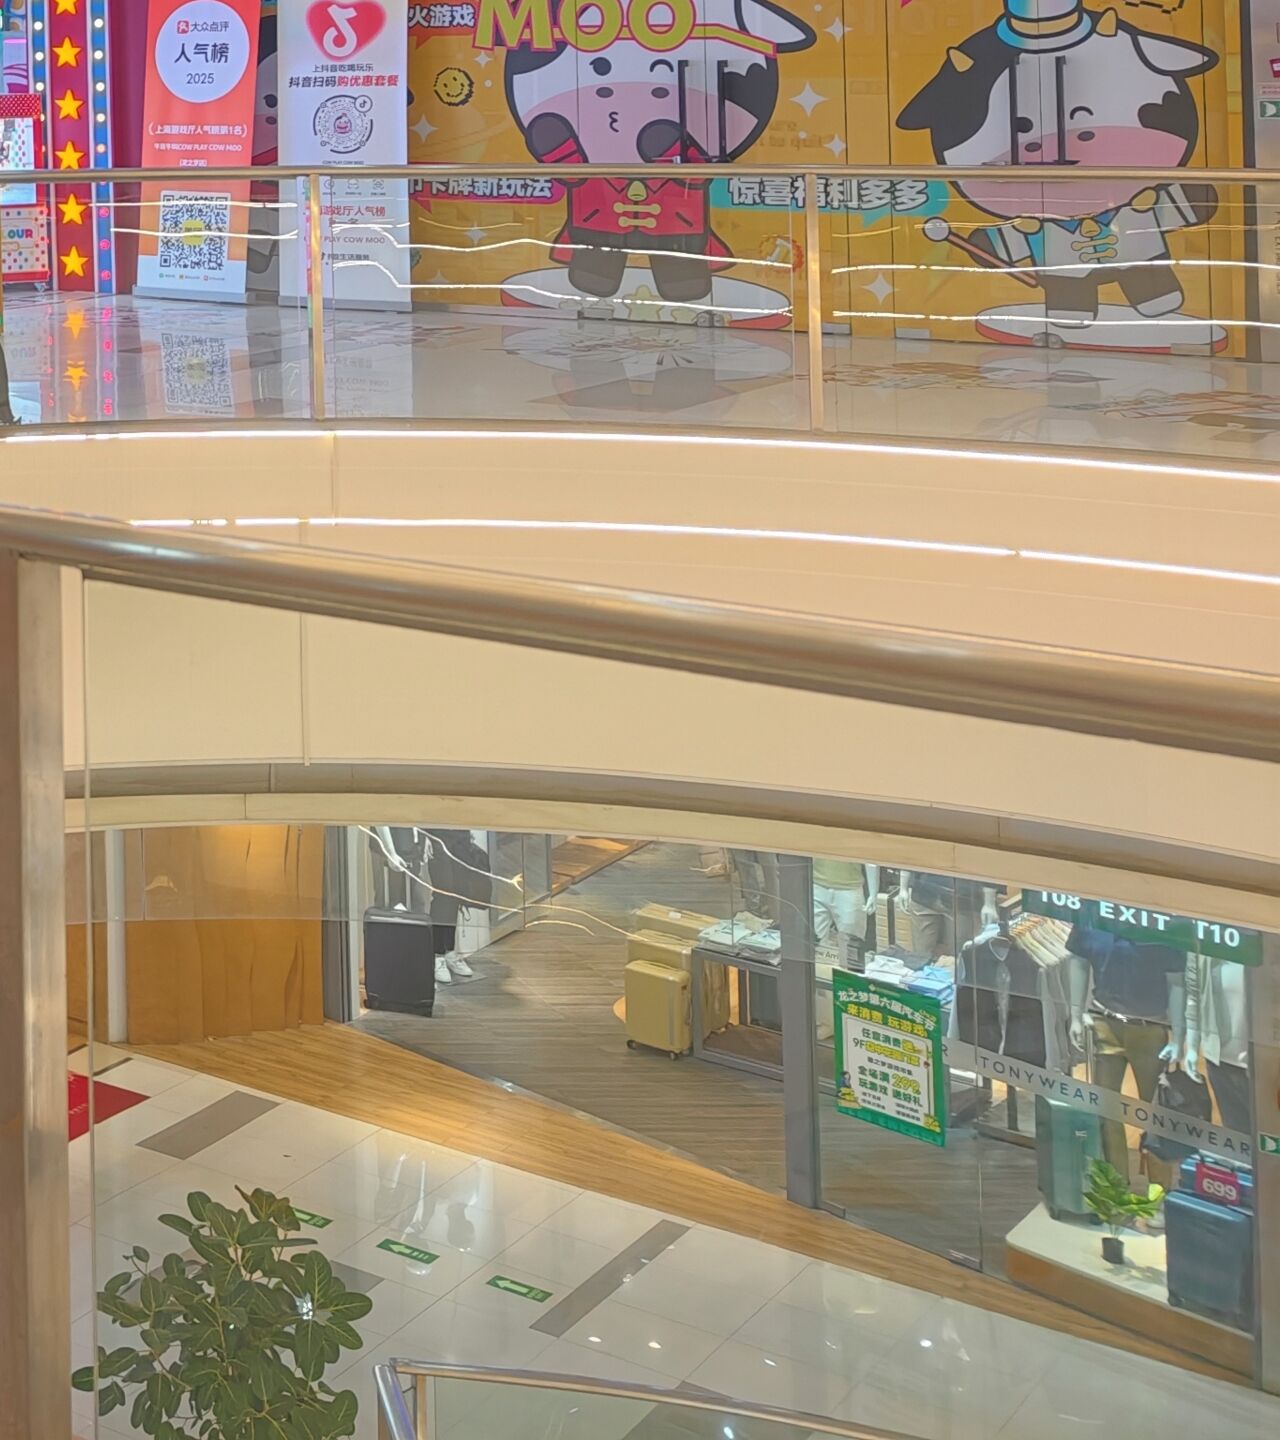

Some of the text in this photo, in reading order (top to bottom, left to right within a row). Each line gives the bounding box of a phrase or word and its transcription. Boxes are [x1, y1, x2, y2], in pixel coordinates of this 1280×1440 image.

[190, 21, 230, 32] 大众点评
[174, 43, 230, 64] 人气榜
[312, 64, 373, 73] 上抖音吃喝玩乐
[186, 73, 215, 85] 2025
[289, 75, 399, 89] 抖音扫码购优惠套餐
[728, 177, 929, 211] 惊喜福利多多
[7, 228, 33, 239] OUR
[365, 236, 385, 244] MOO
[1099, 900, 1171, 931] EXIT
[1192, 919, 1240, 948] T10
[980, 1056, 1251, 1156] TONYWEAR TONYWEAR
[1202, 1176, 1238, 1201] 699
